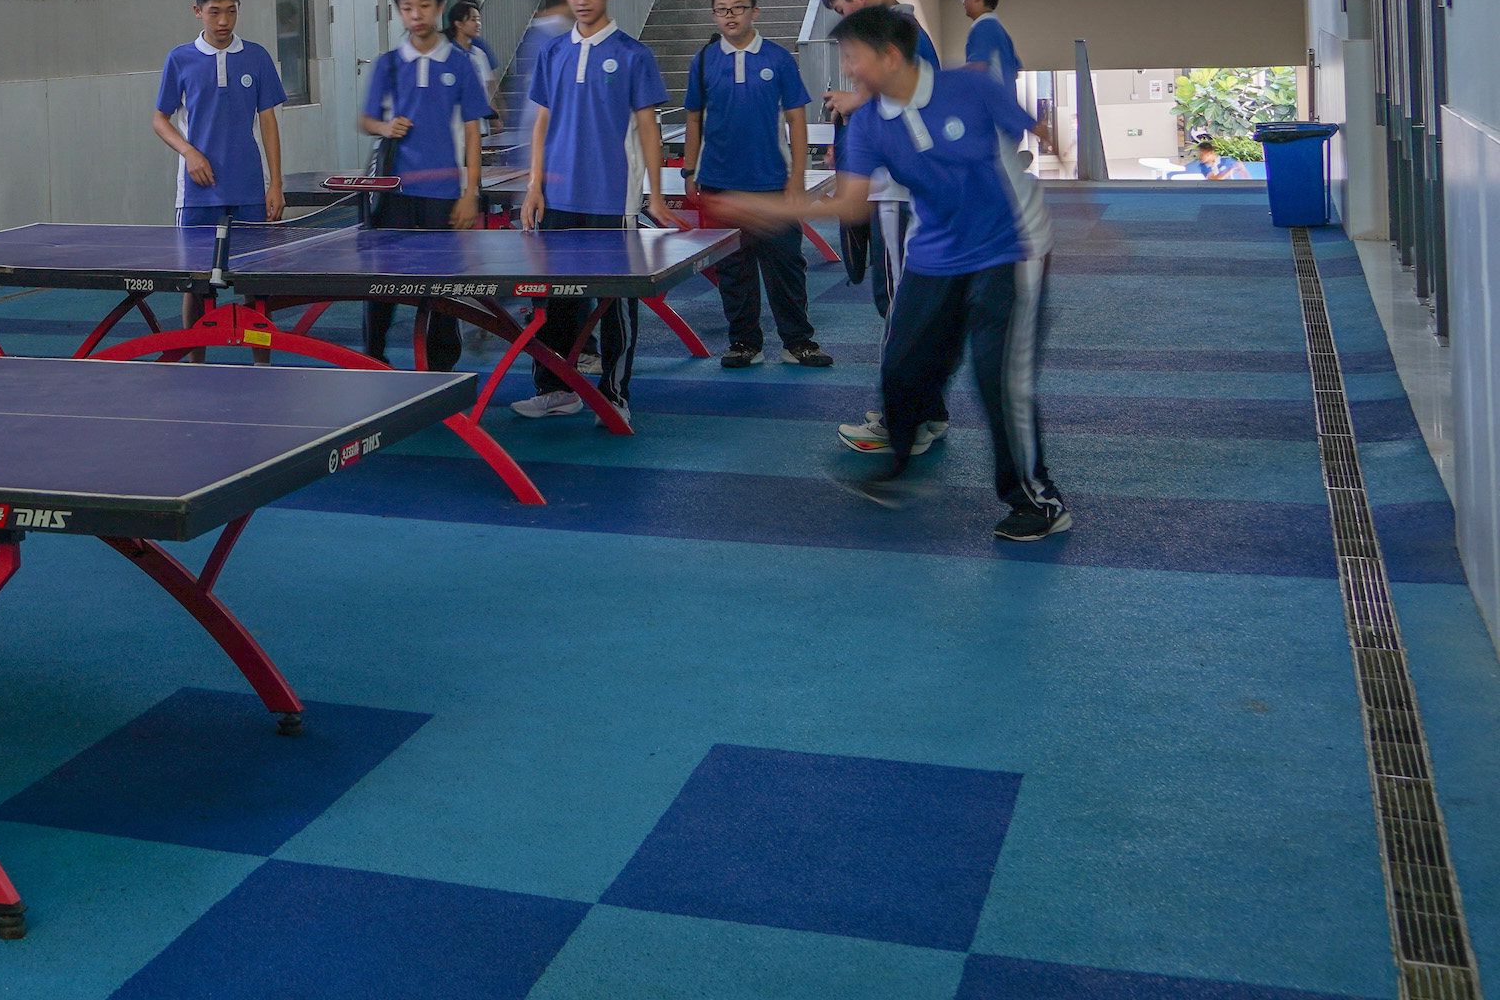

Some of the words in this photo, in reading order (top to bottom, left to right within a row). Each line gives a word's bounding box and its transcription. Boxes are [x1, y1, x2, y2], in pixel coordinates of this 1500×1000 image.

[123, 278, 154, 291] T2828
[430, 283, 498, 296] 世乒赛供应商
[551, 284, 588, 295] DHS
[362, 431, 382, 455] DHS
[13, 508, 73, 529] DHS
